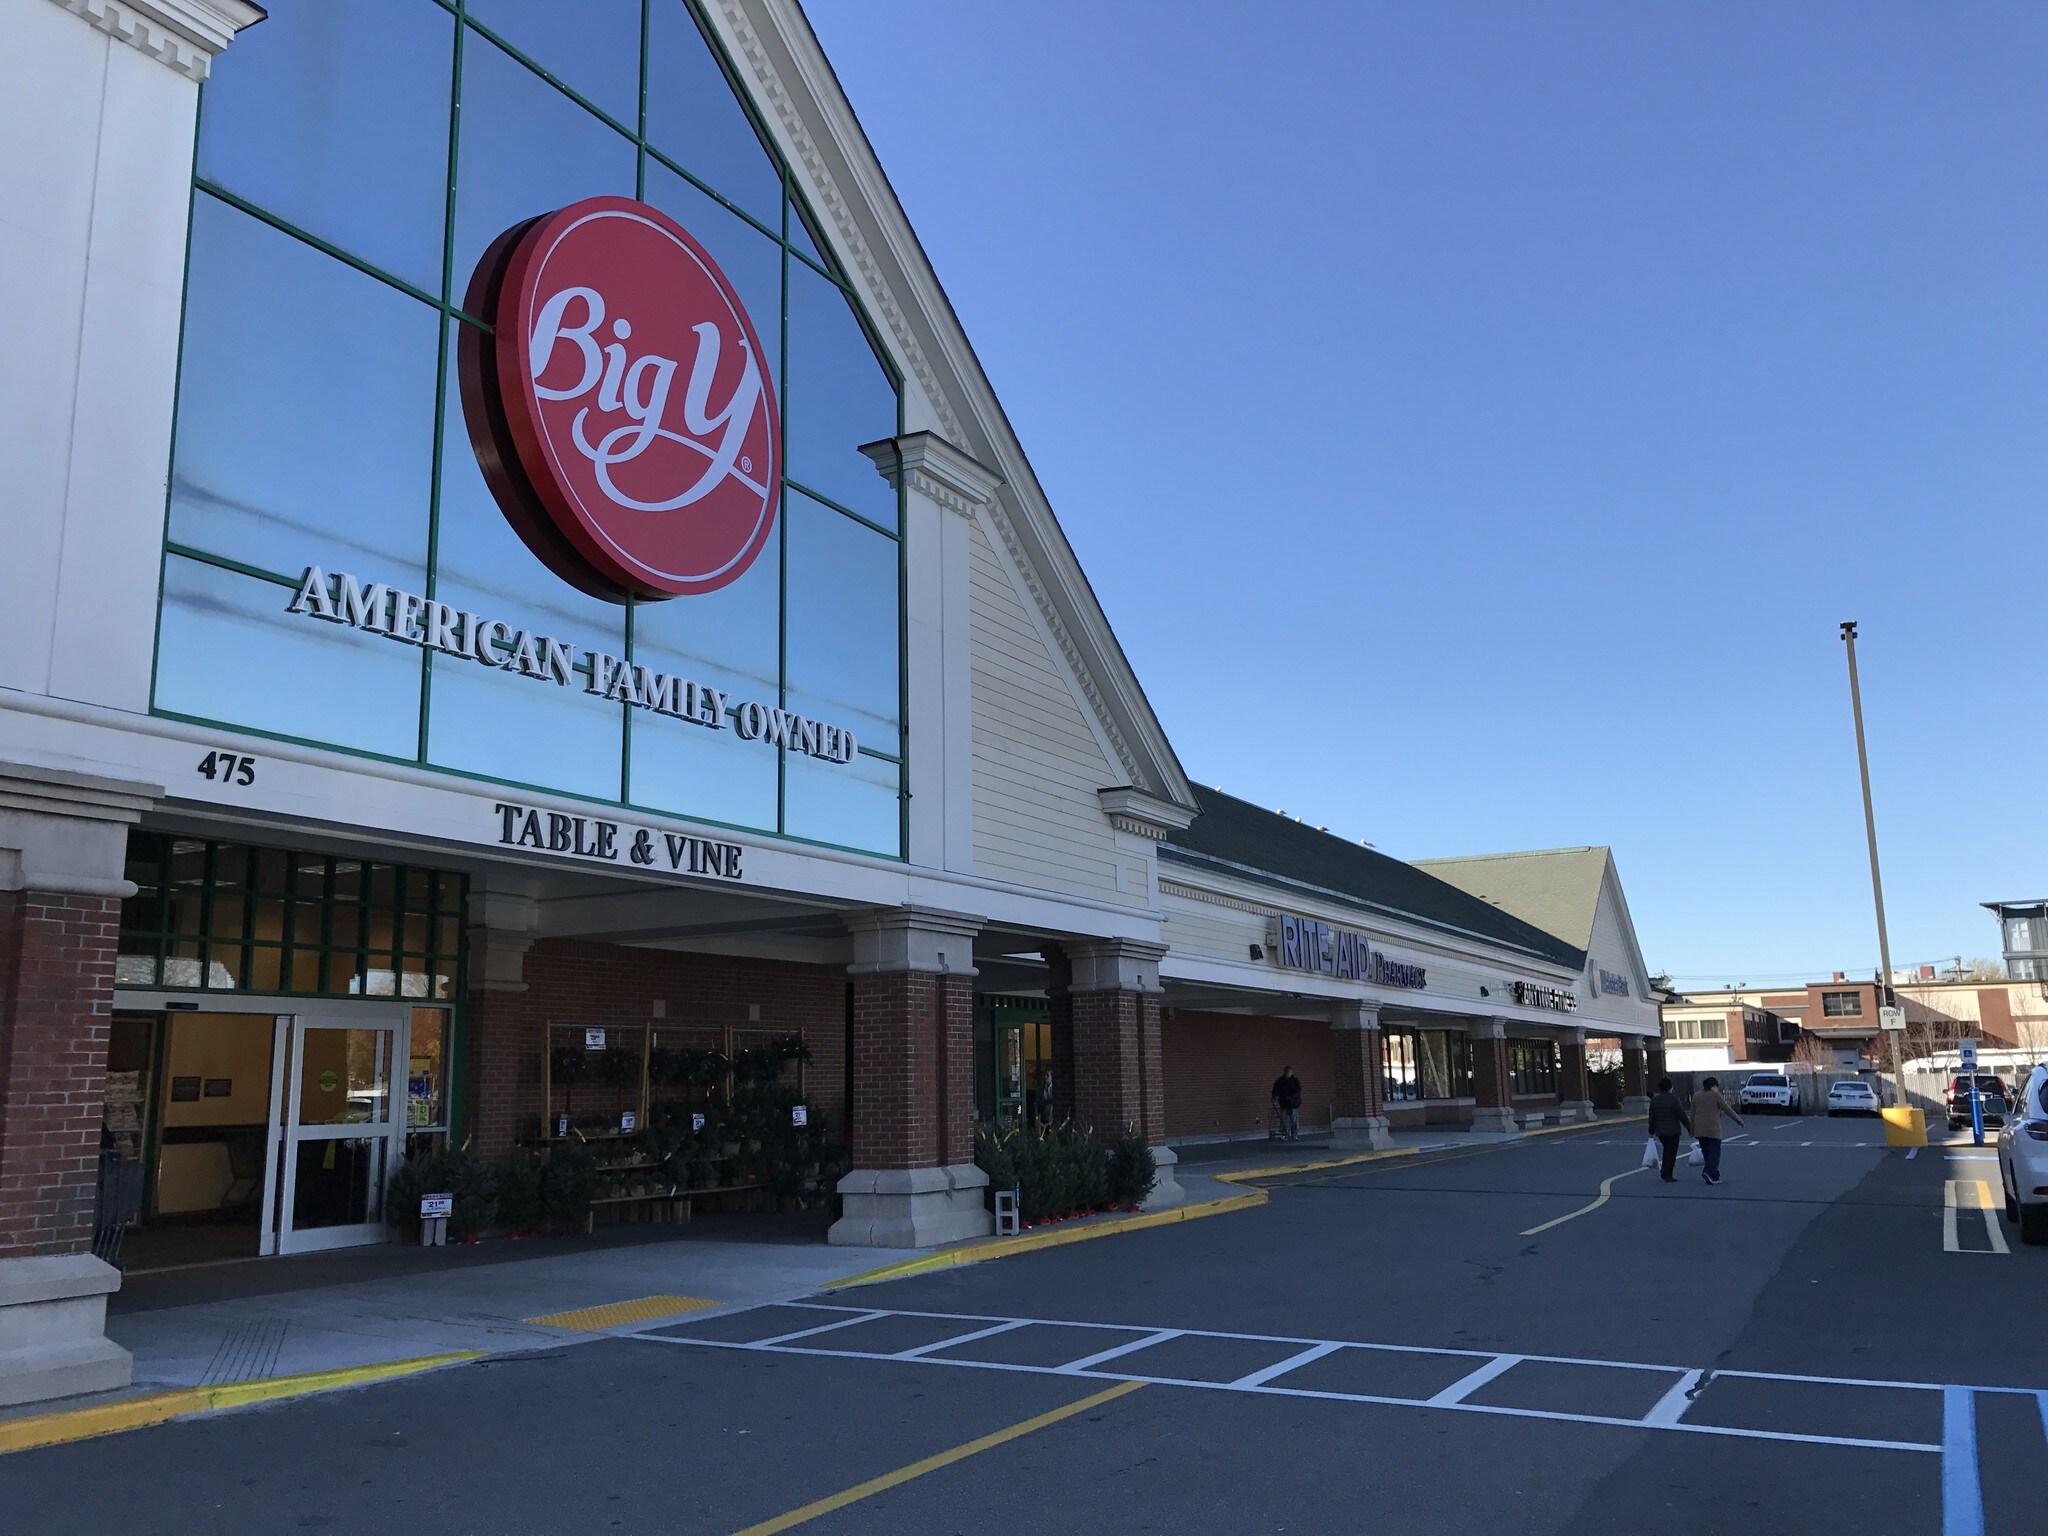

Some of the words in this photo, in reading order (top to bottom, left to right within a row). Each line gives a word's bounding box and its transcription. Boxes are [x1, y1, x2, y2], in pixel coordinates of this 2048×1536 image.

[530, 286, 678, 464] Big
[286, 565, 577, 686] AMERICAN
[584, 651, 731, 729] FAMILY
[734, 702, 858, 764] OWNED
[197, 751, 256, 786] 475
[495, 803, 618, 860] TABLE
[630, 829, 655, 865] &
[664, 834, 743, 879] VINE
[1279, 914, 1332, 972] RITE
[1336, 930, 1371, 981] AID
[1882, 1009, 1900, 1017] ROW
